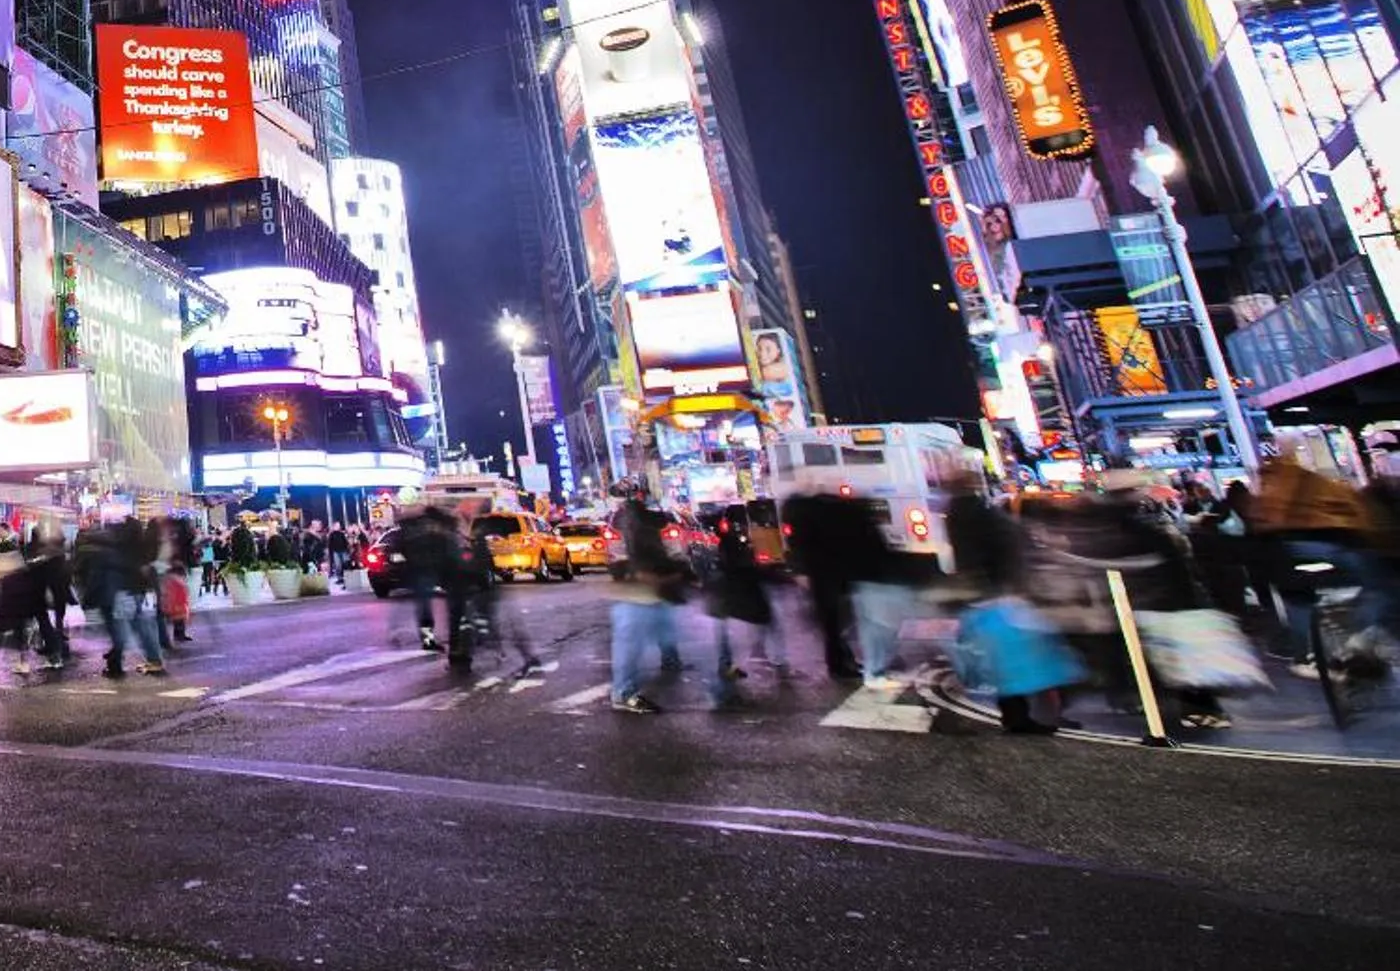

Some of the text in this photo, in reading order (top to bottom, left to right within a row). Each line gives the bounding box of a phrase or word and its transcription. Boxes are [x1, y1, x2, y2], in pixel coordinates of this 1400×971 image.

[122, 39, 224, 66] Congress
[123, 64, 225, 83] should carve
[123, 84, 228, 100] spending like a
[123, 99, 229, 120] Thanksgiving
[259, 177, 276, 236] 1500
[922, 141, 979, 288] YOUNG
